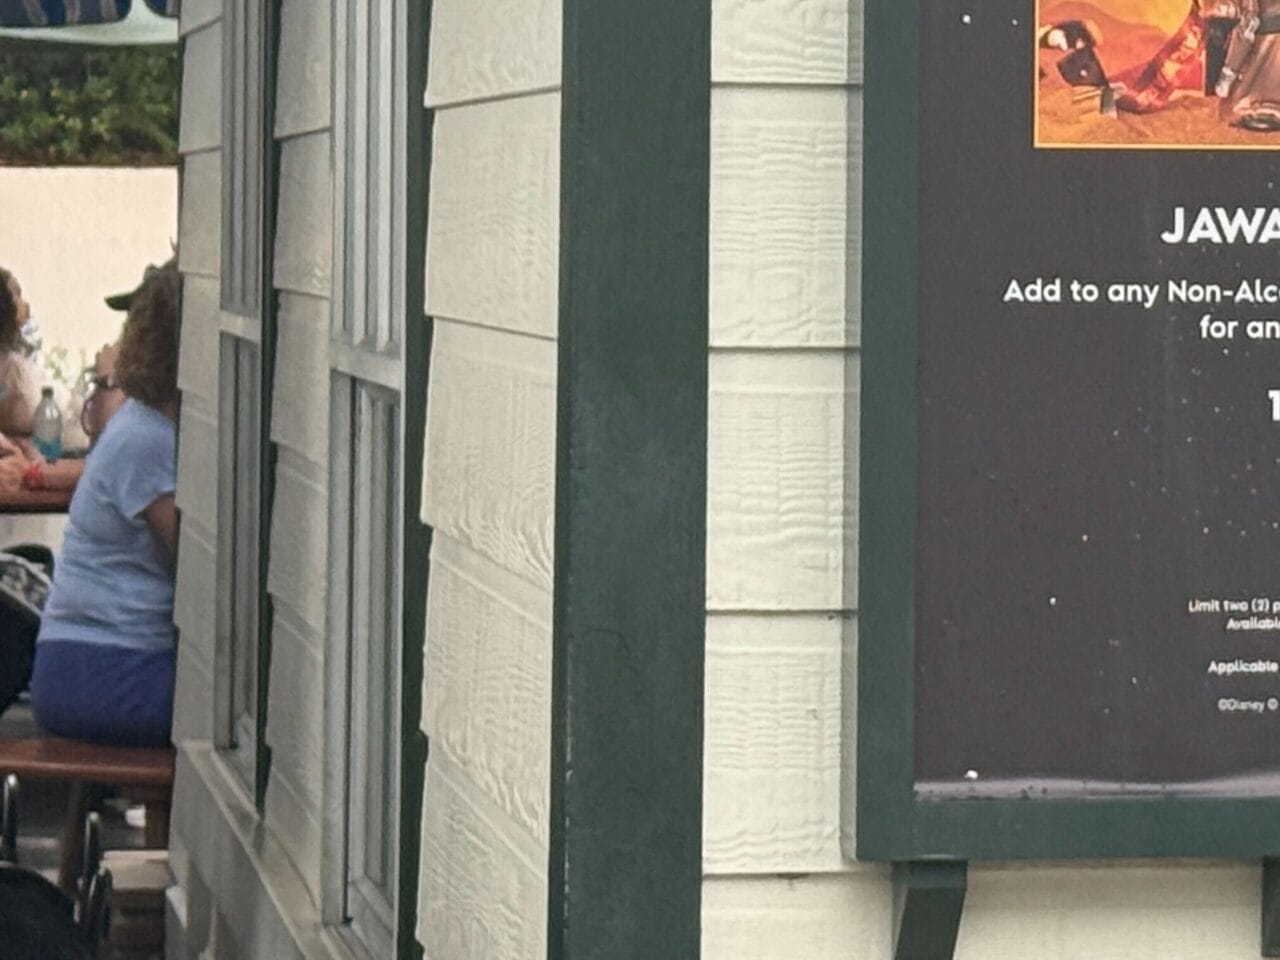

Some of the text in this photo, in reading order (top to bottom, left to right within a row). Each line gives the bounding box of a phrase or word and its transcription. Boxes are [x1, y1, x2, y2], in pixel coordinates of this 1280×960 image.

[1004, 278, 1060, 301] Add
[1071, 280, 1098, 301] to
[1108, 285, 1159, 308] any
[1200, 315, 1238, 338] for
[1247, 321, 1280, 338] an
[1188, 599, 1221, 613] Limit
[1223, 599, 1249, 612] two
[1251, 597, 1270, 613] (2)
[1207, 659, 1279, 676] Applicable
